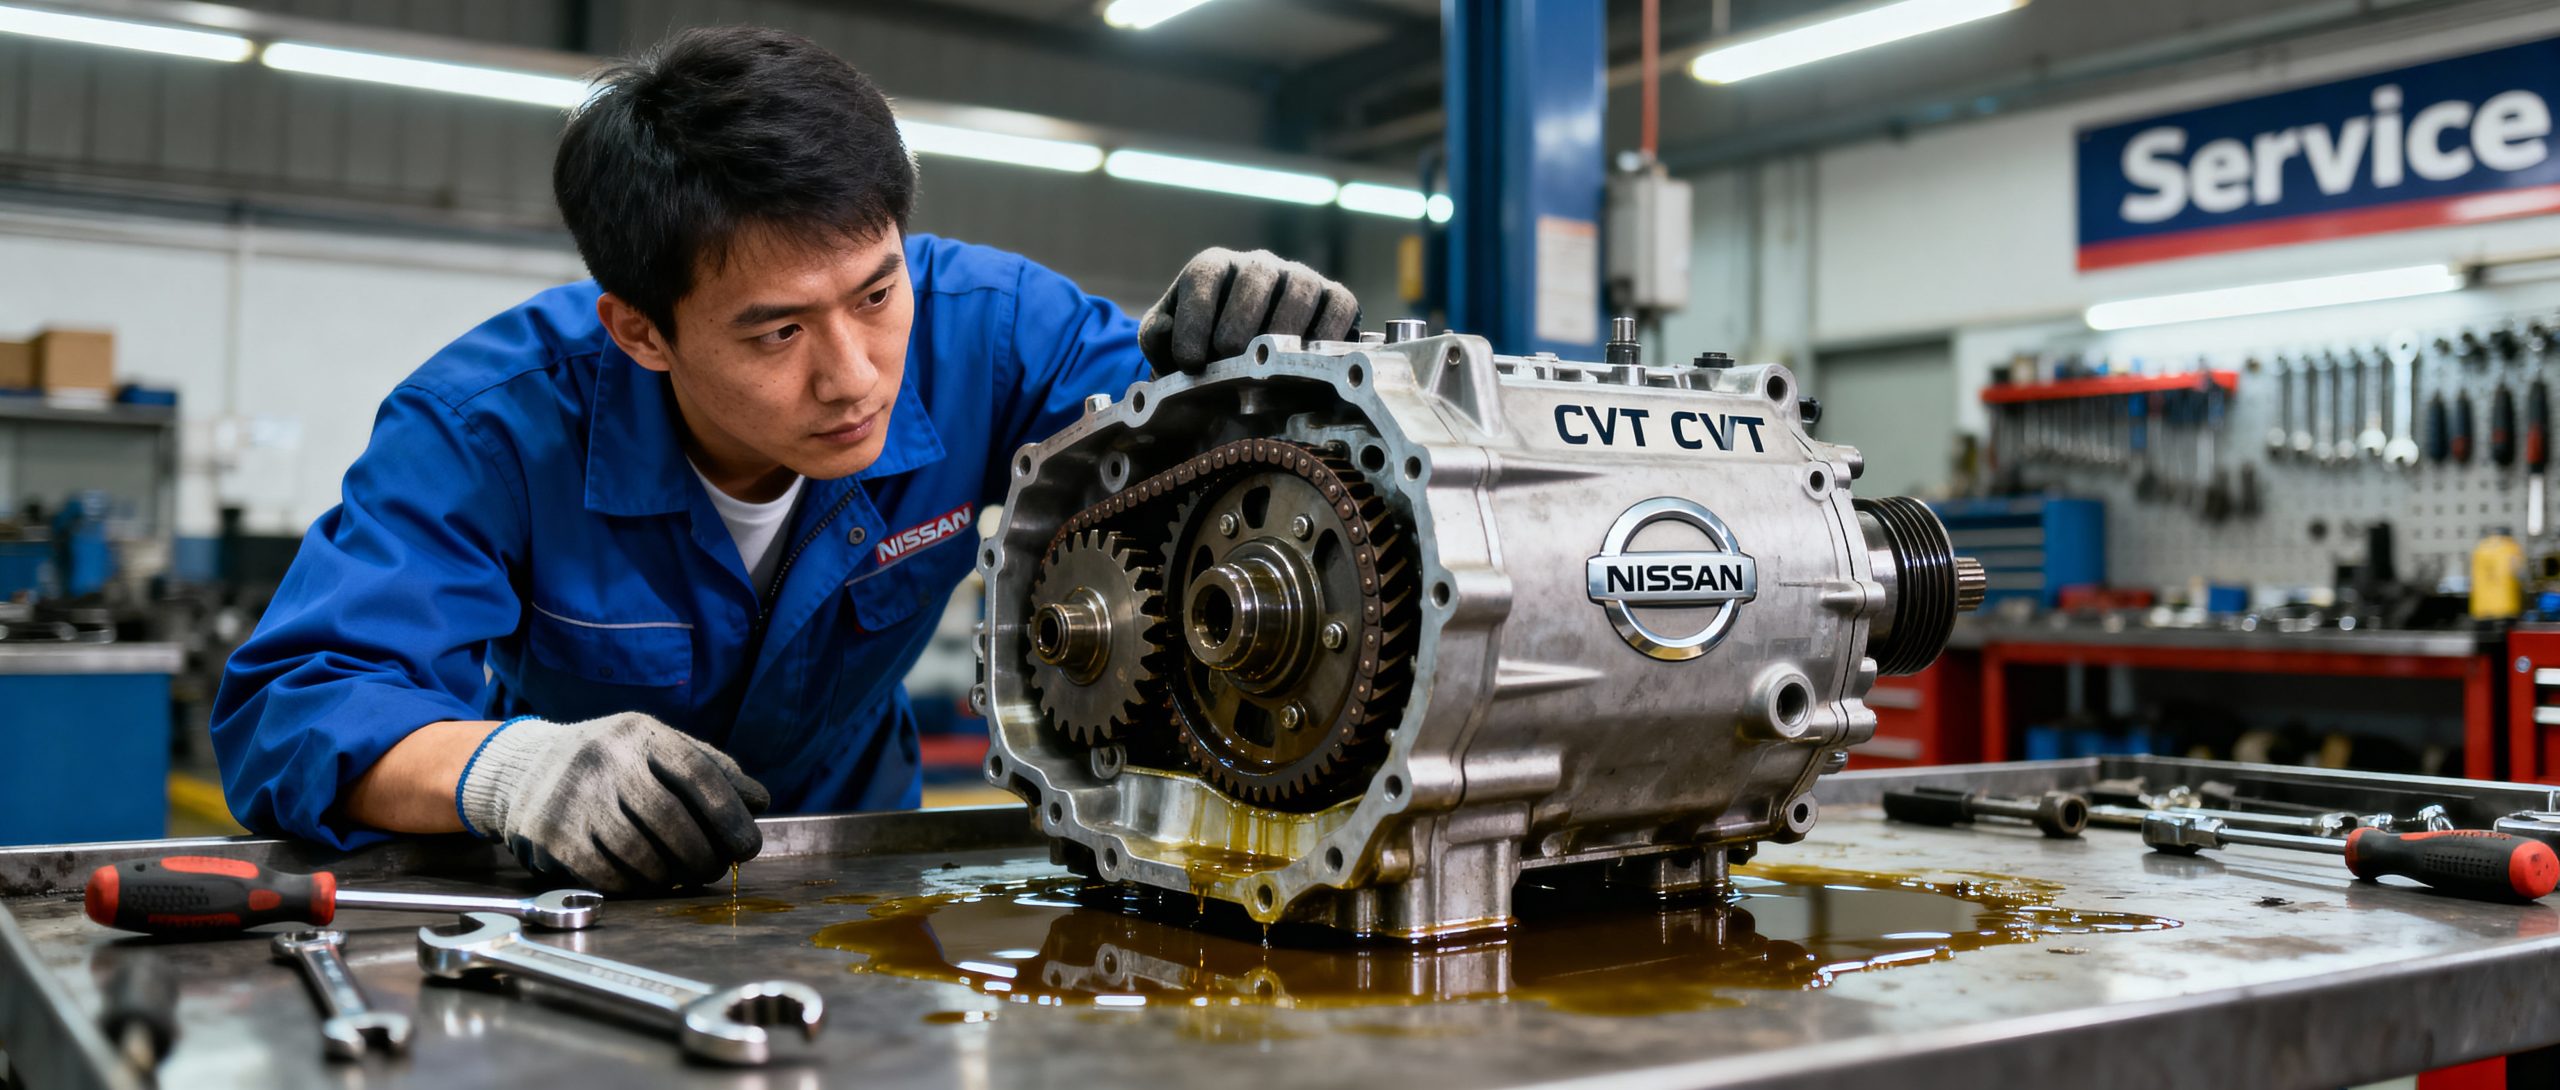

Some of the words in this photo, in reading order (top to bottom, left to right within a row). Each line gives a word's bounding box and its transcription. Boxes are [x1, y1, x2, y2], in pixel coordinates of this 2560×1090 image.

[2119, 84, 2552, 224] Service
[1554, 404, 1649, 447] CVT
[1671, 411, 1765, 453] CVT
[877, 507, 971, 561] NISSAN
[1607, 565, 1743, 593] NISSAN
